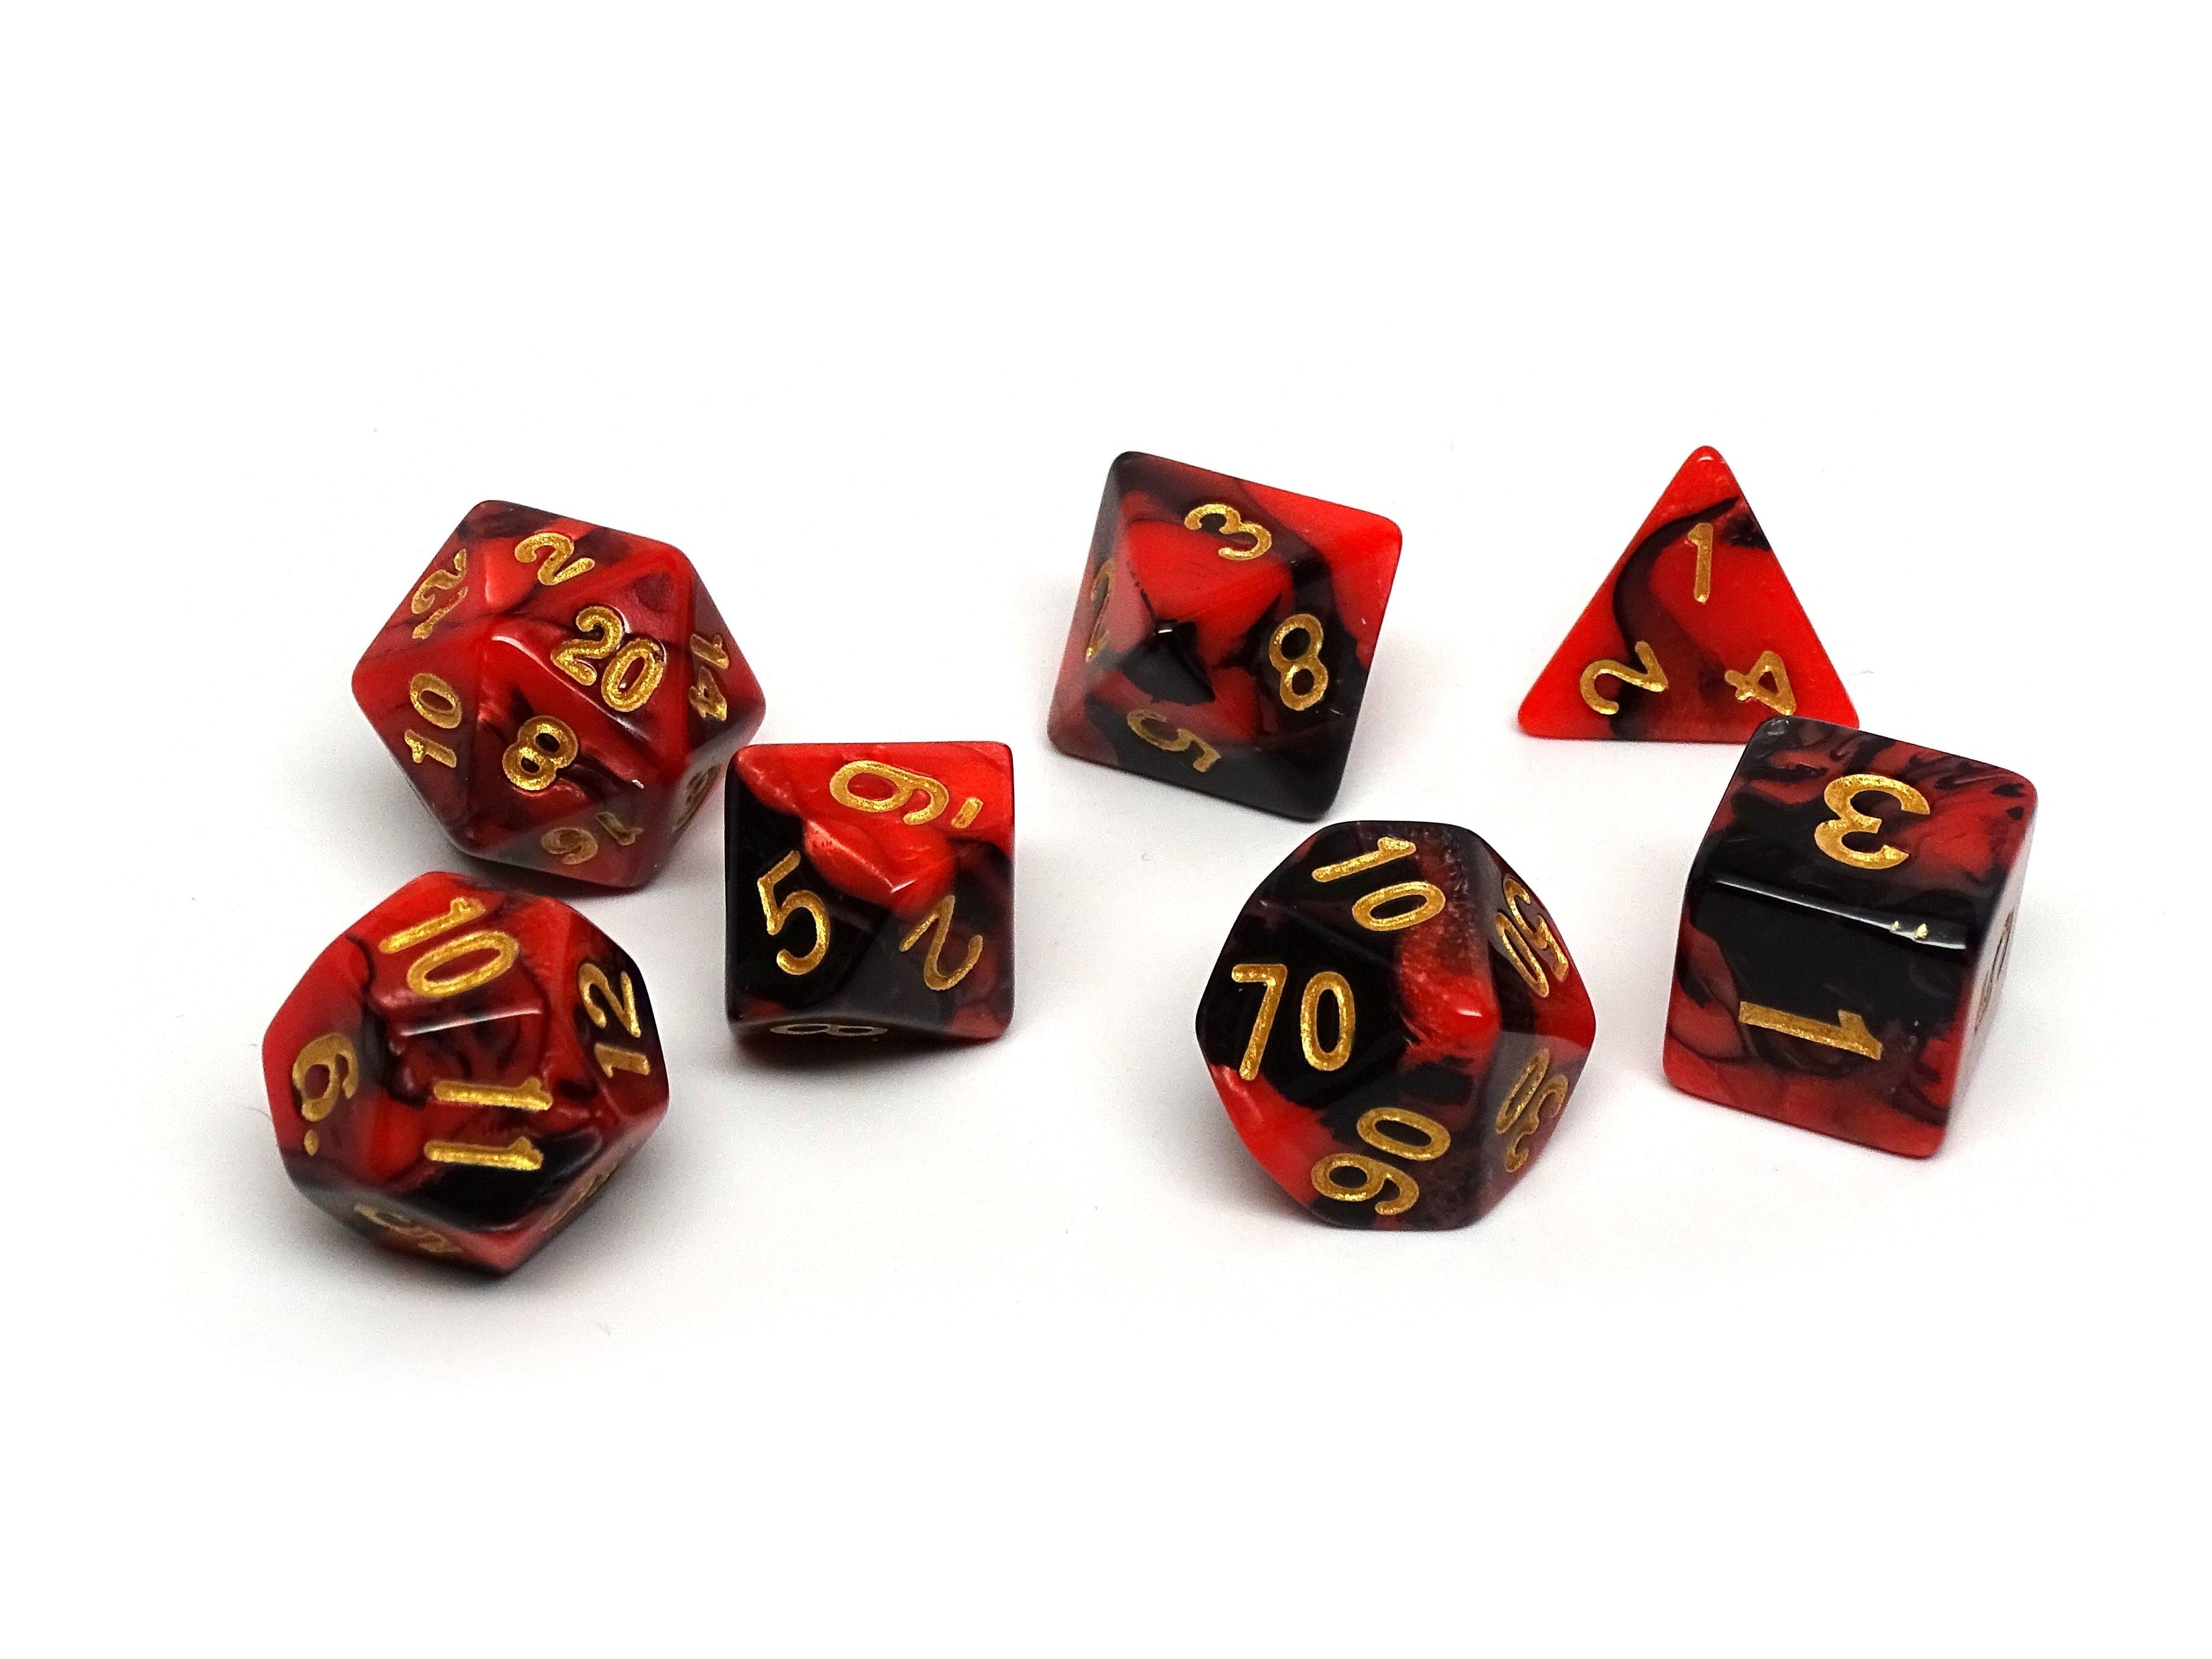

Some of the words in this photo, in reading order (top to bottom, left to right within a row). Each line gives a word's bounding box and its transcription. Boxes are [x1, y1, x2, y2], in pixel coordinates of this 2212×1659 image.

[514, 533, 596, 586] 2
[1184, 503, 1272, 561] 3
[1686, 522, 1713, 605] 1
[411, 549, 468, 639] 12
[550, 605, 665, 713] 20
[689, 633, 729, 721] 14
[1269, 613, 1328, 711] 8
[1579, 641, 1670, 716] 2
[1724, 650, 1796, 716] 4
[404, 672, 461, 768] 10
[502, 715, 578, 790] 8
[1127, 708, 1221, 773] 5
[540, 812, 644, 865] 16
[1814, 774, 1931, 870] 3
[757, 850, 830, 976] 5
[1311, 836, 1446, 931] 10
[379, 897, 519, 998] 10
[900, 895, 984, 991] 2
[1495, 877, 1569, 998] 50
[578, 962, 650, 1077] 12
[770, 1023, 888, 1037] 8
[1231, 963, 1356, 1081] 70
[1738, 1001, 1883, 1061] 1
[424, 1077, 553, 1171] 11
[1495, 1048, 1569, 1173] 30
[1311, 1107, 1452, 1216] 90
